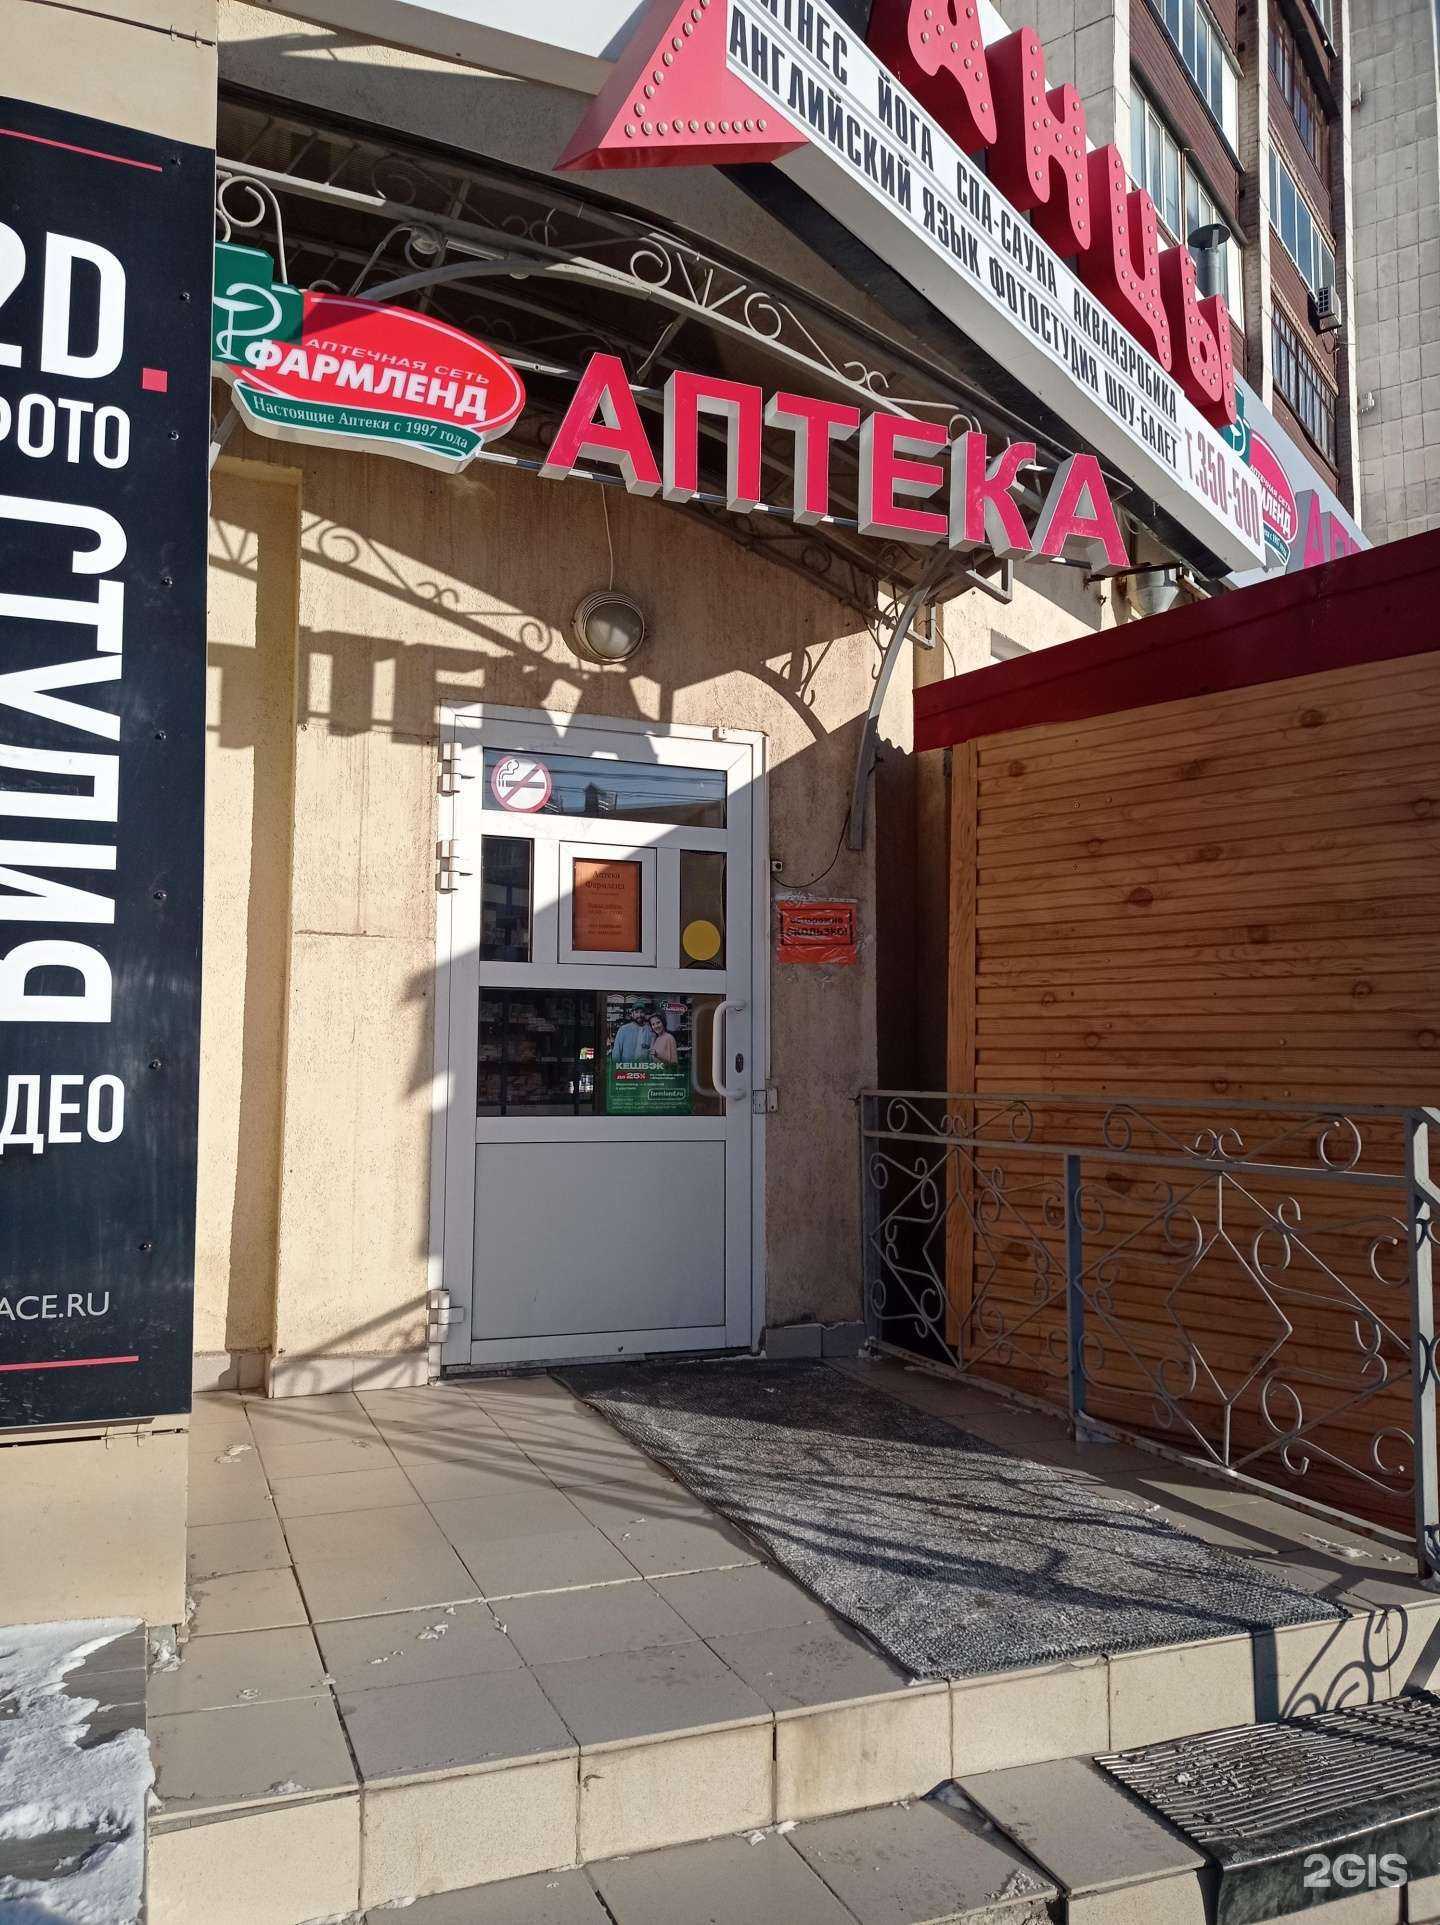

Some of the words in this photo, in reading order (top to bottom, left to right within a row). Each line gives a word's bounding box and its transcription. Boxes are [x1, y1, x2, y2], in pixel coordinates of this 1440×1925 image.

[729, 5, 912, 214] АНГЛИЙСКИЙ
[922, 185, 981, 280] ЯЗЫК
[989, 258, 1100, 394] ФОТОСТУДИЯ
[1105, 372, 1178, 470] ШОУ-БАЛЕТ
[878, 69, 934, 172] ЙОГА
[956, 171, 1058, 299] СПА-САУНА
[1073, 290, 1178, 424] АКВААЭРОБИКА
[244, 338, 489, 422] ФАРМЛЕНД
[304, 338, 428, 371] АПТЕЧНАЯ
[433, 365, 490, 385] СЕТЬ
[253, 395, 335, 425] Настоящие
[337, 412, 390, 432] Аптеки
[394, 421, 401, 432] с
[405, 421, 437, 438] 1997
[439, 429, 469, 450] года
[541, 352, 1131, 572] АПТЕКА
[1303, 489, 1361, 568] АП
[615, 1062, 665, 1070] КЕШБЭК
